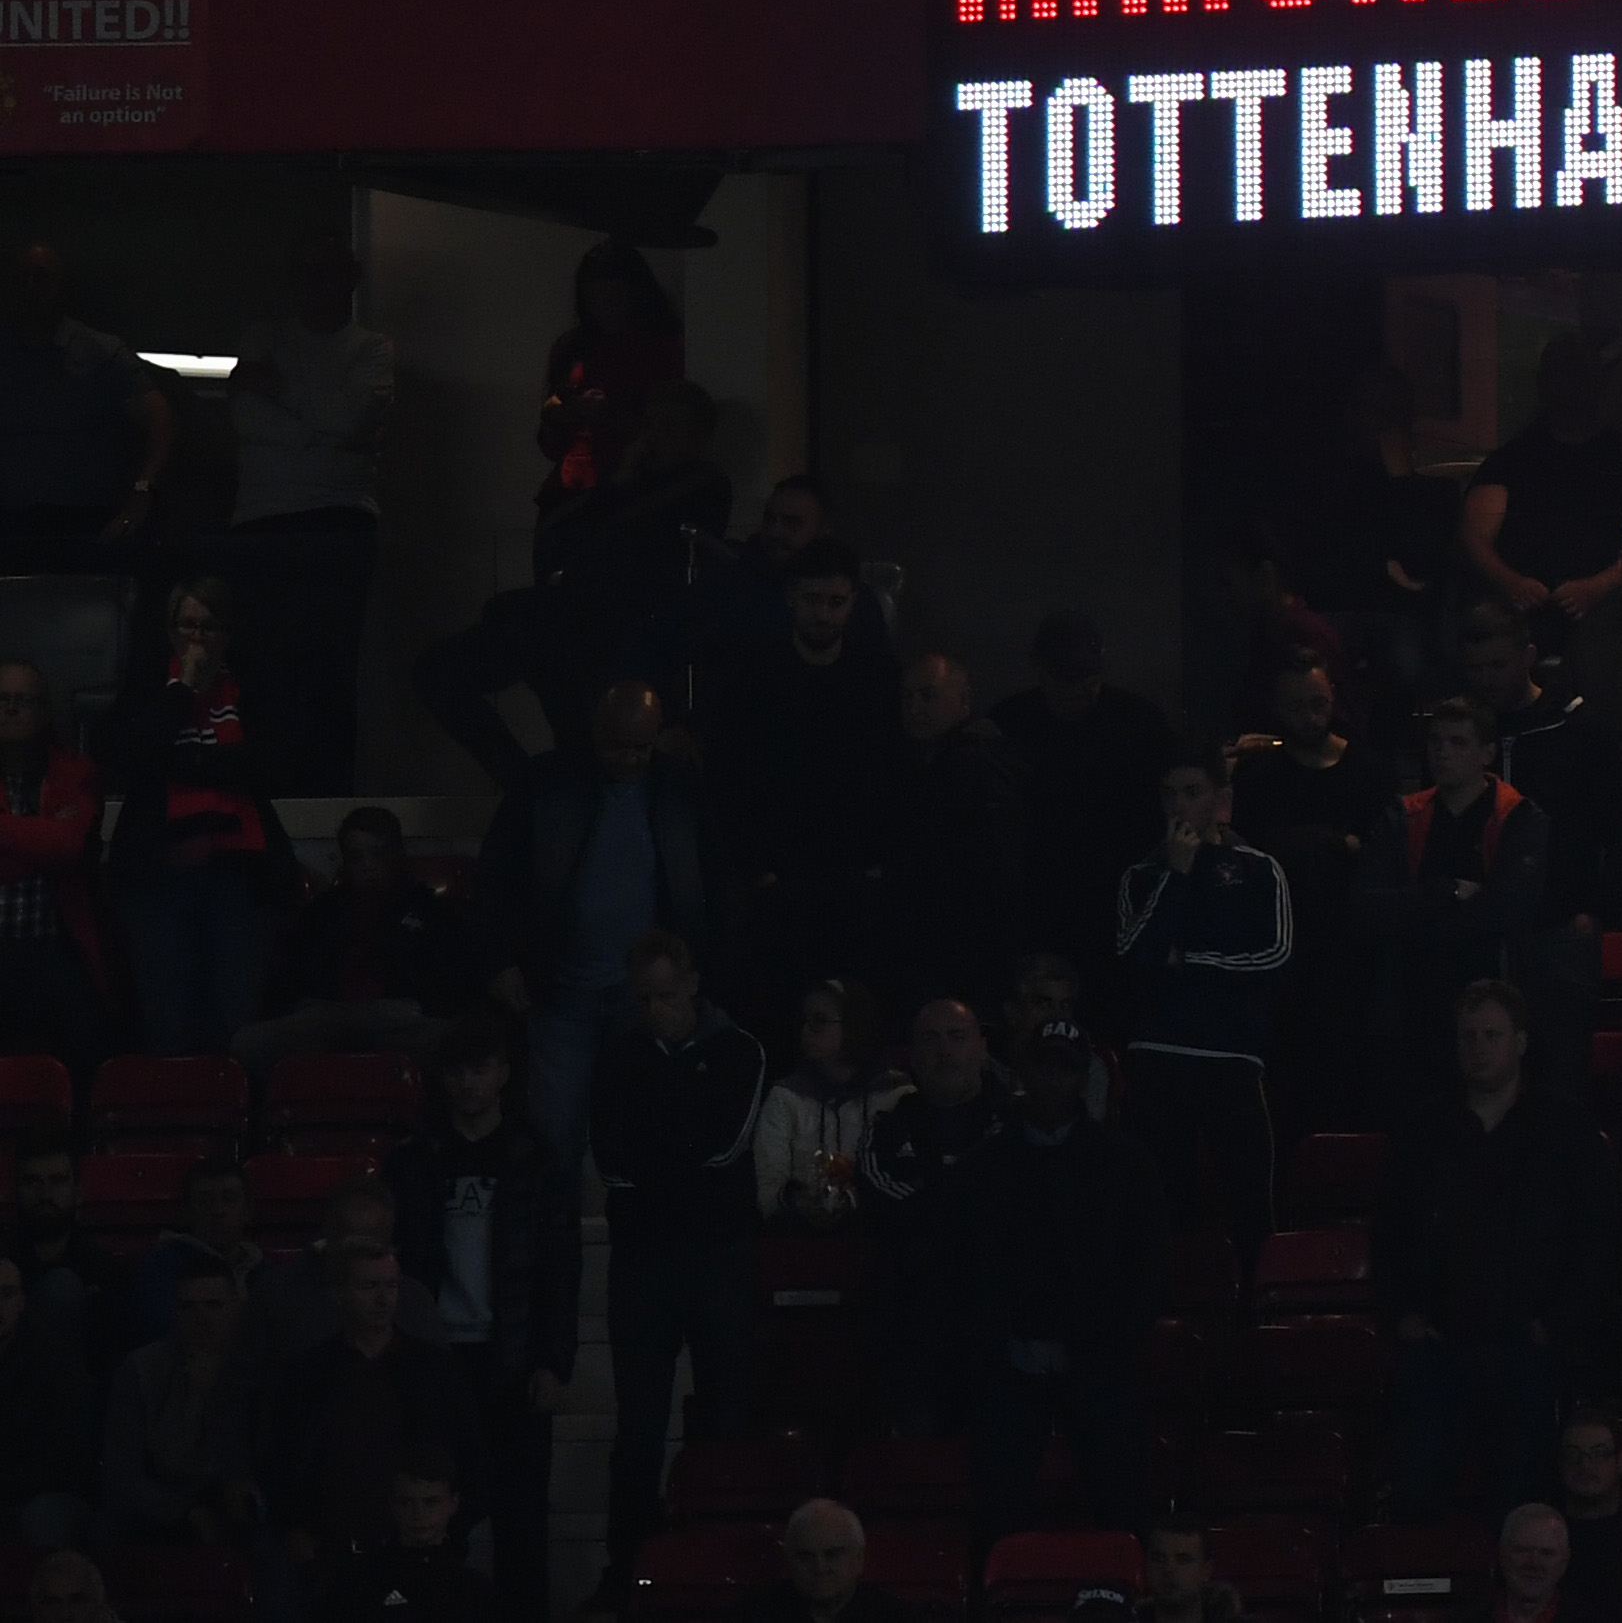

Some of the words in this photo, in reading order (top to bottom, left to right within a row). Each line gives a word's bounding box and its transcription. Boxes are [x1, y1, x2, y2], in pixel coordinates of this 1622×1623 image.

[0, 0, 191, 41] NITED!!
[126, 83, 141, 100] is
[146, 83, 183, 100] Not
[59, 110, 84, 124] an
[1041, 1020, 1080, 1040] GAP
